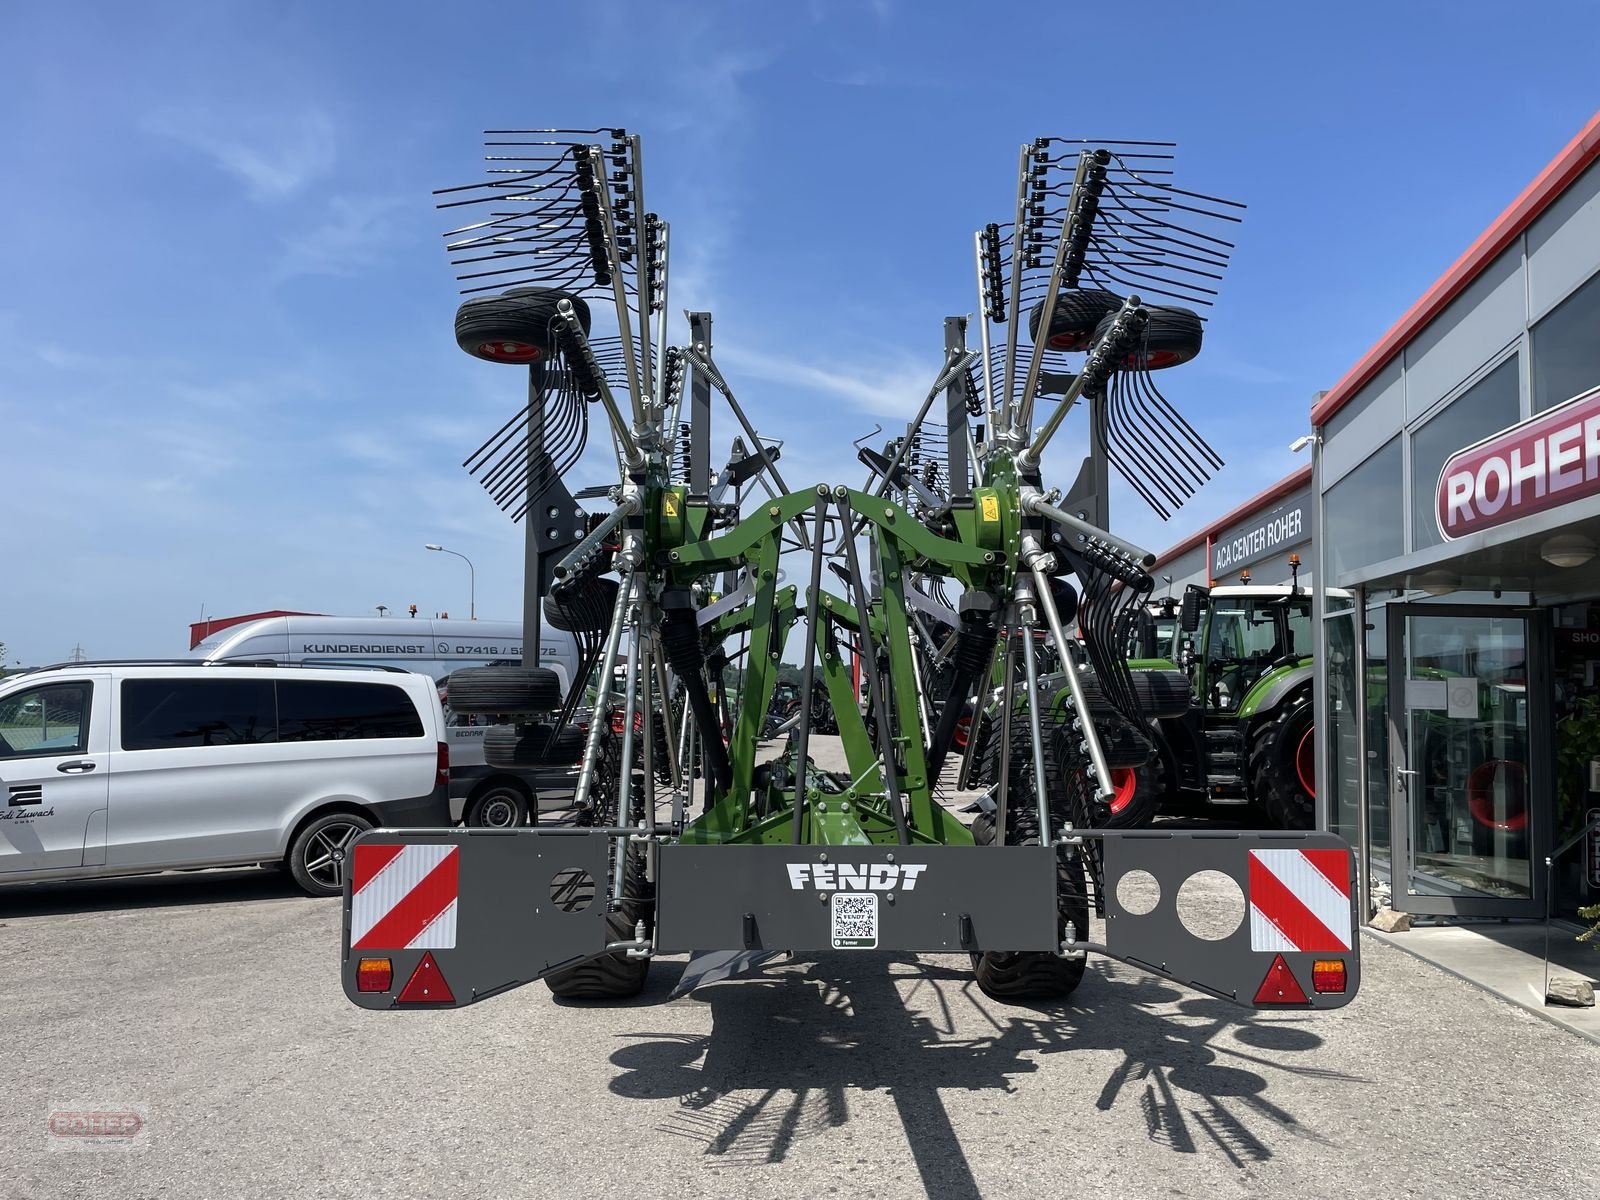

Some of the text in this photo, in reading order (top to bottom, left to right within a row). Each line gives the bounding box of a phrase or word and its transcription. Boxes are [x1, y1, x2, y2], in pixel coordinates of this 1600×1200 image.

[1216, 508, 1302, 570] ACA CENTER ROHER
[303, 644, 424, 653] KUNDENDIENST
[456, 646, 498, 654] 07416
[16, 806, 54, 819] Zuwach
[786, 863, 927, 891] FENDT
